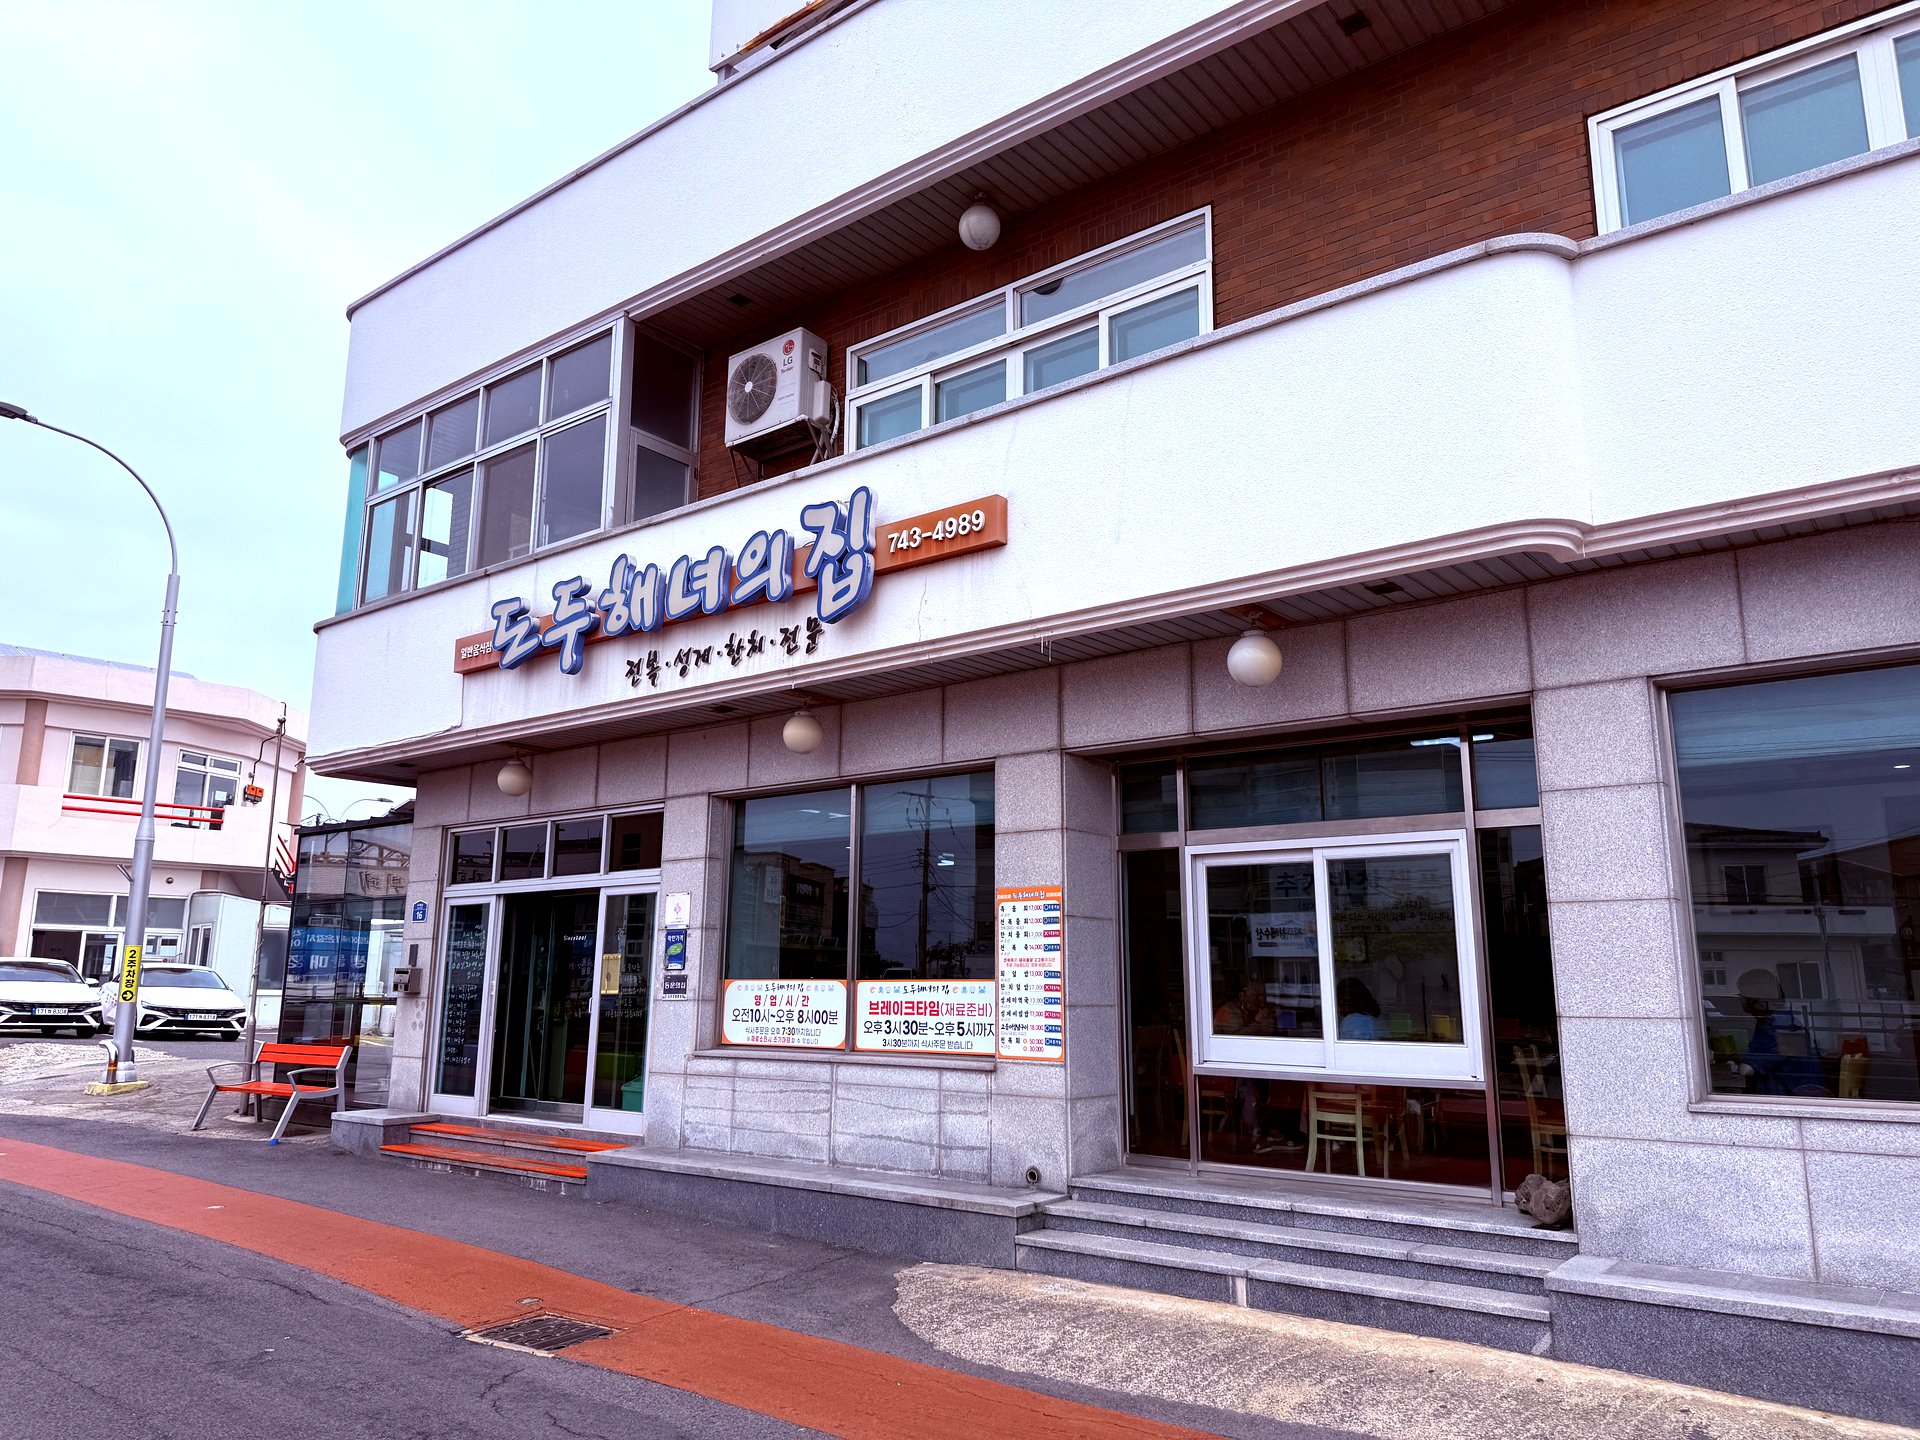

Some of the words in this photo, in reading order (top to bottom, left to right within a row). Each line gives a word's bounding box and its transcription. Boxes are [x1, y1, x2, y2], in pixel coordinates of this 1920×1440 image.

[783, 356, 793, 367] LG
[889, 508, 987, 554] 743-4989
[460, 641, 493, 660] 일반음식점
[416, 911, 423, 920] 16
[869, 1000, 993, 1017] 브레이크타임(재료준비)
[731, 1008, 795, 1024] 오전10시~오후
[797, 1009, 838, 1025] 8시00분
[771, 1027, 781, 1035] 오후
[863, 1020, 882, 1034] 오후
[882, 1038, 920, 1048] 3시30분까지
[921, 1039, 946, 1049] 식사주문
[947, 1040, 974, 1050] 받습니다
